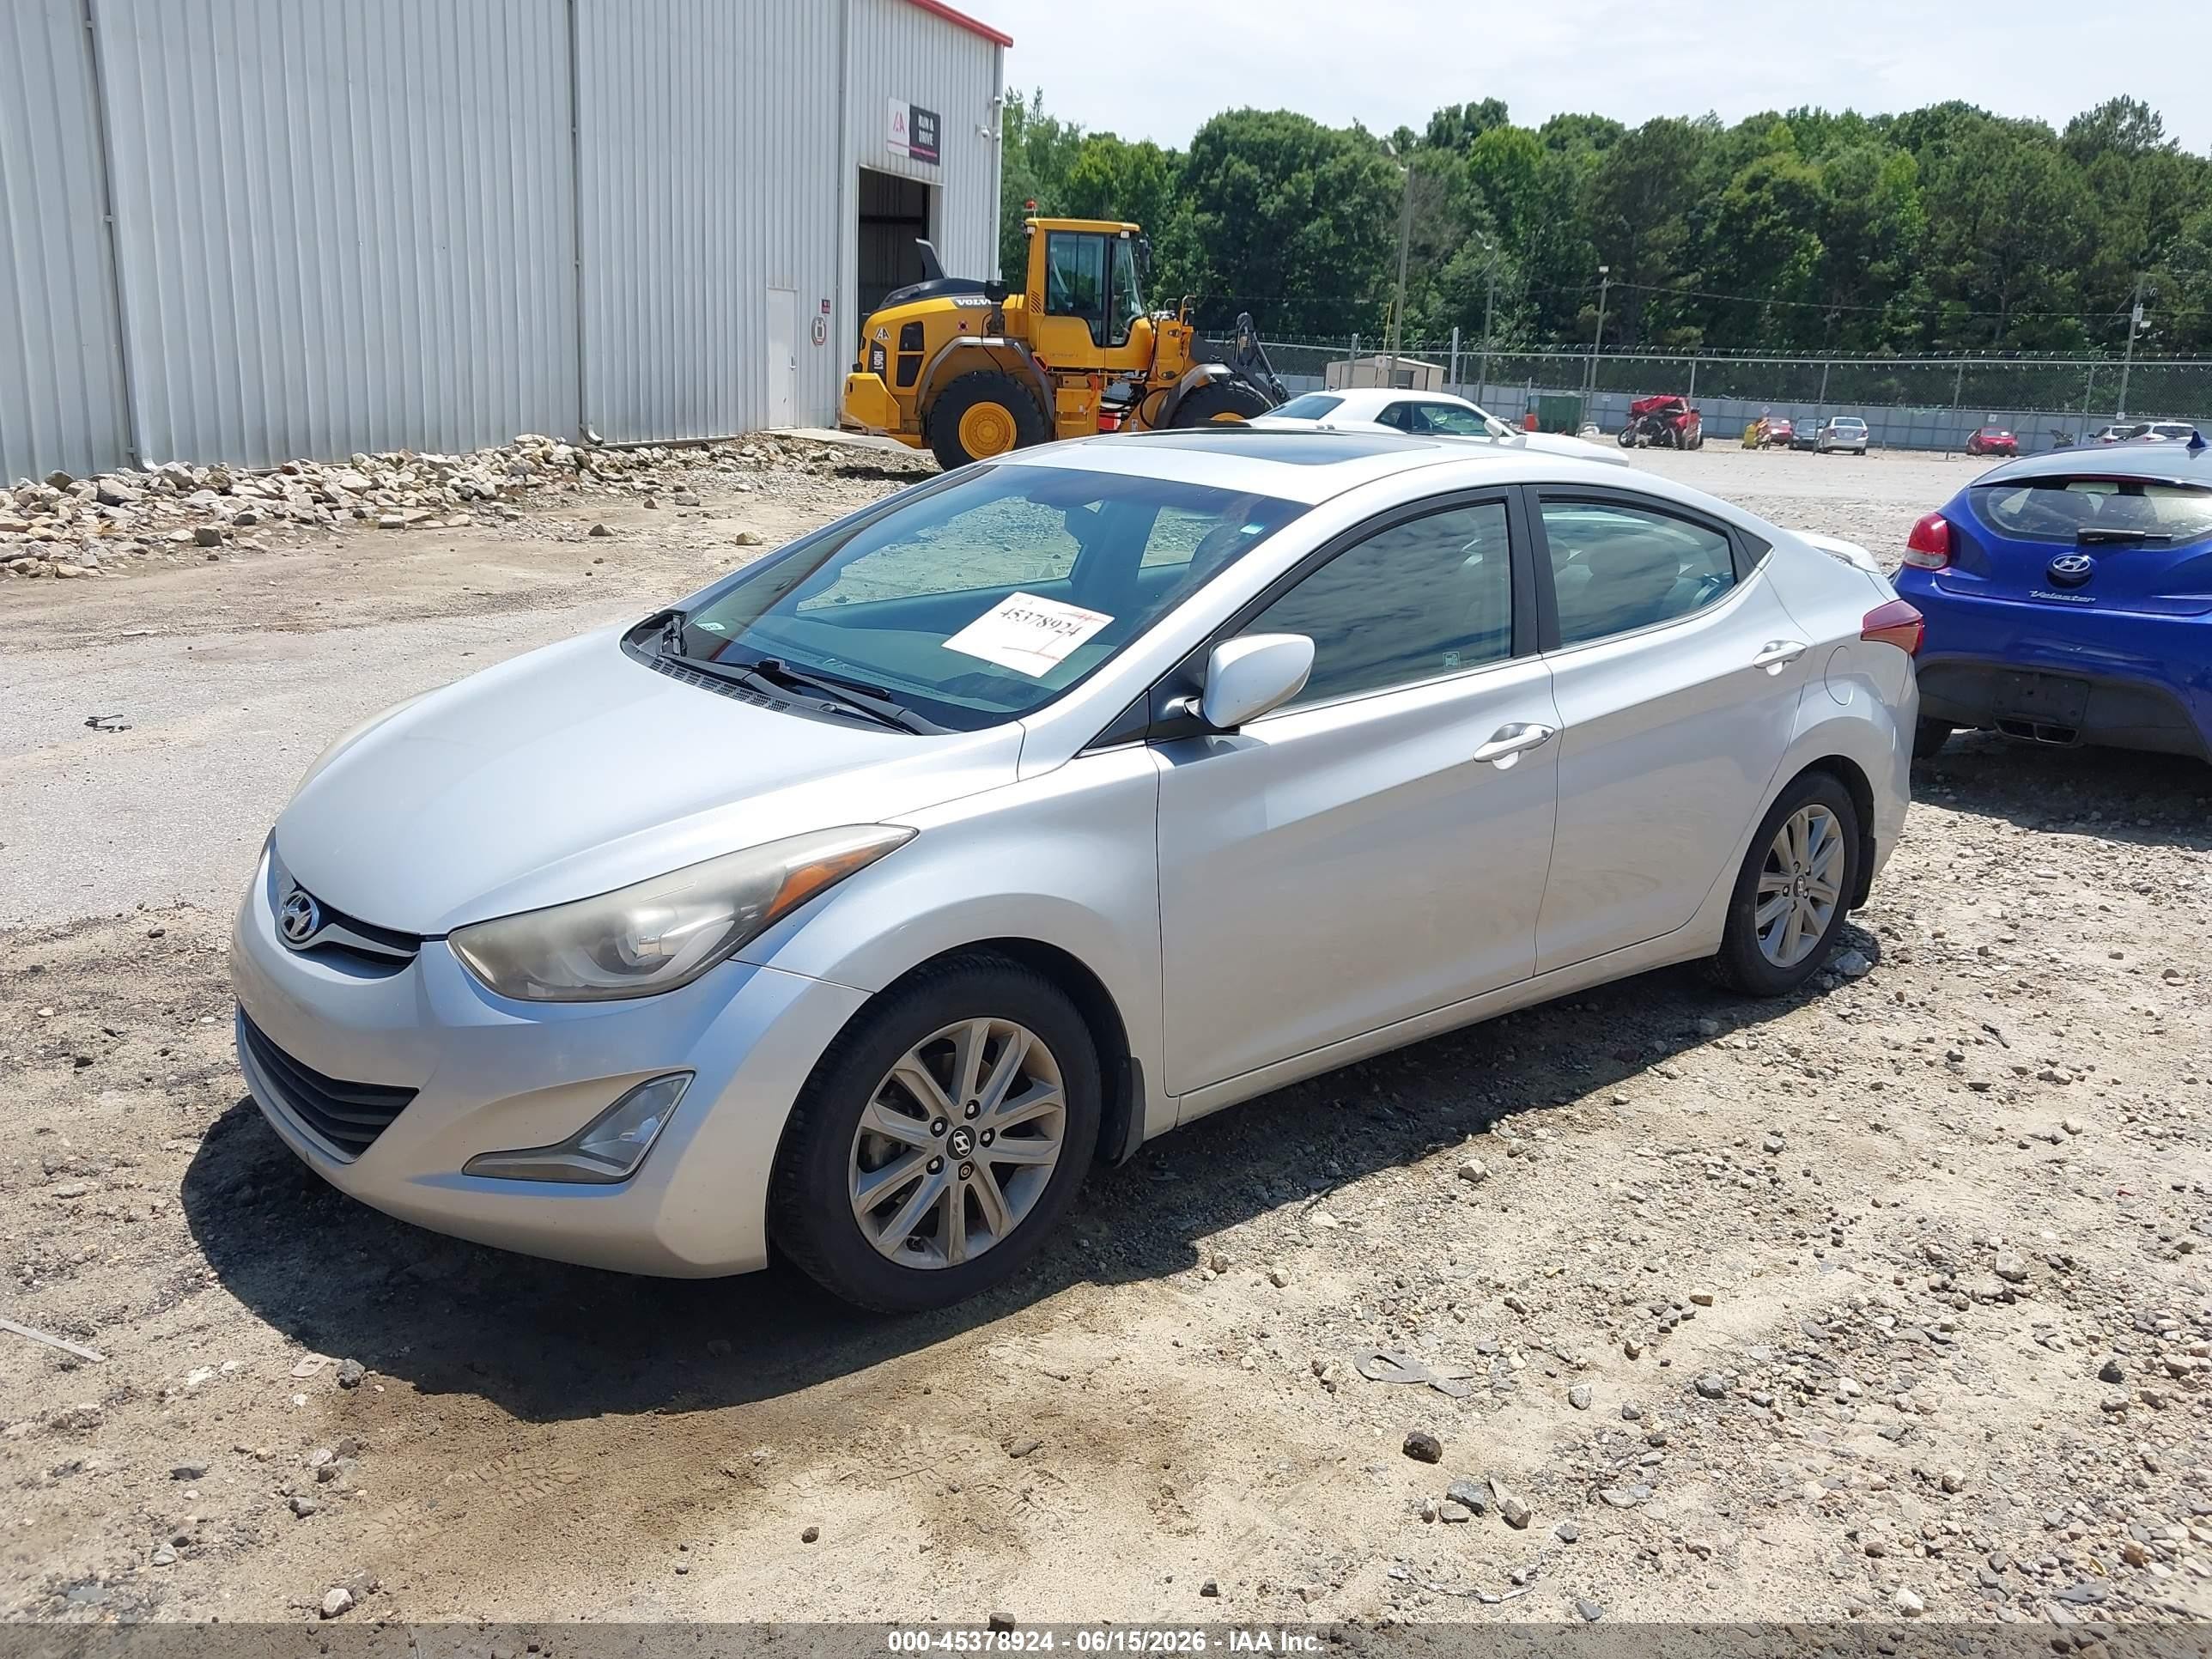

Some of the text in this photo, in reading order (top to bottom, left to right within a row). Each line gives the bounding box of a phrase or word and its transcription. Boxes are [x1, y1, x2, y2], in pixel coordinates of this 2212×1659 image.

[918, 128, 934, 146] DRIVE
[873, 350, 884, 370] L90H
[2028, 590, 2096, 602] Veloster
[1000, 607, 1083, 637] 45378924
